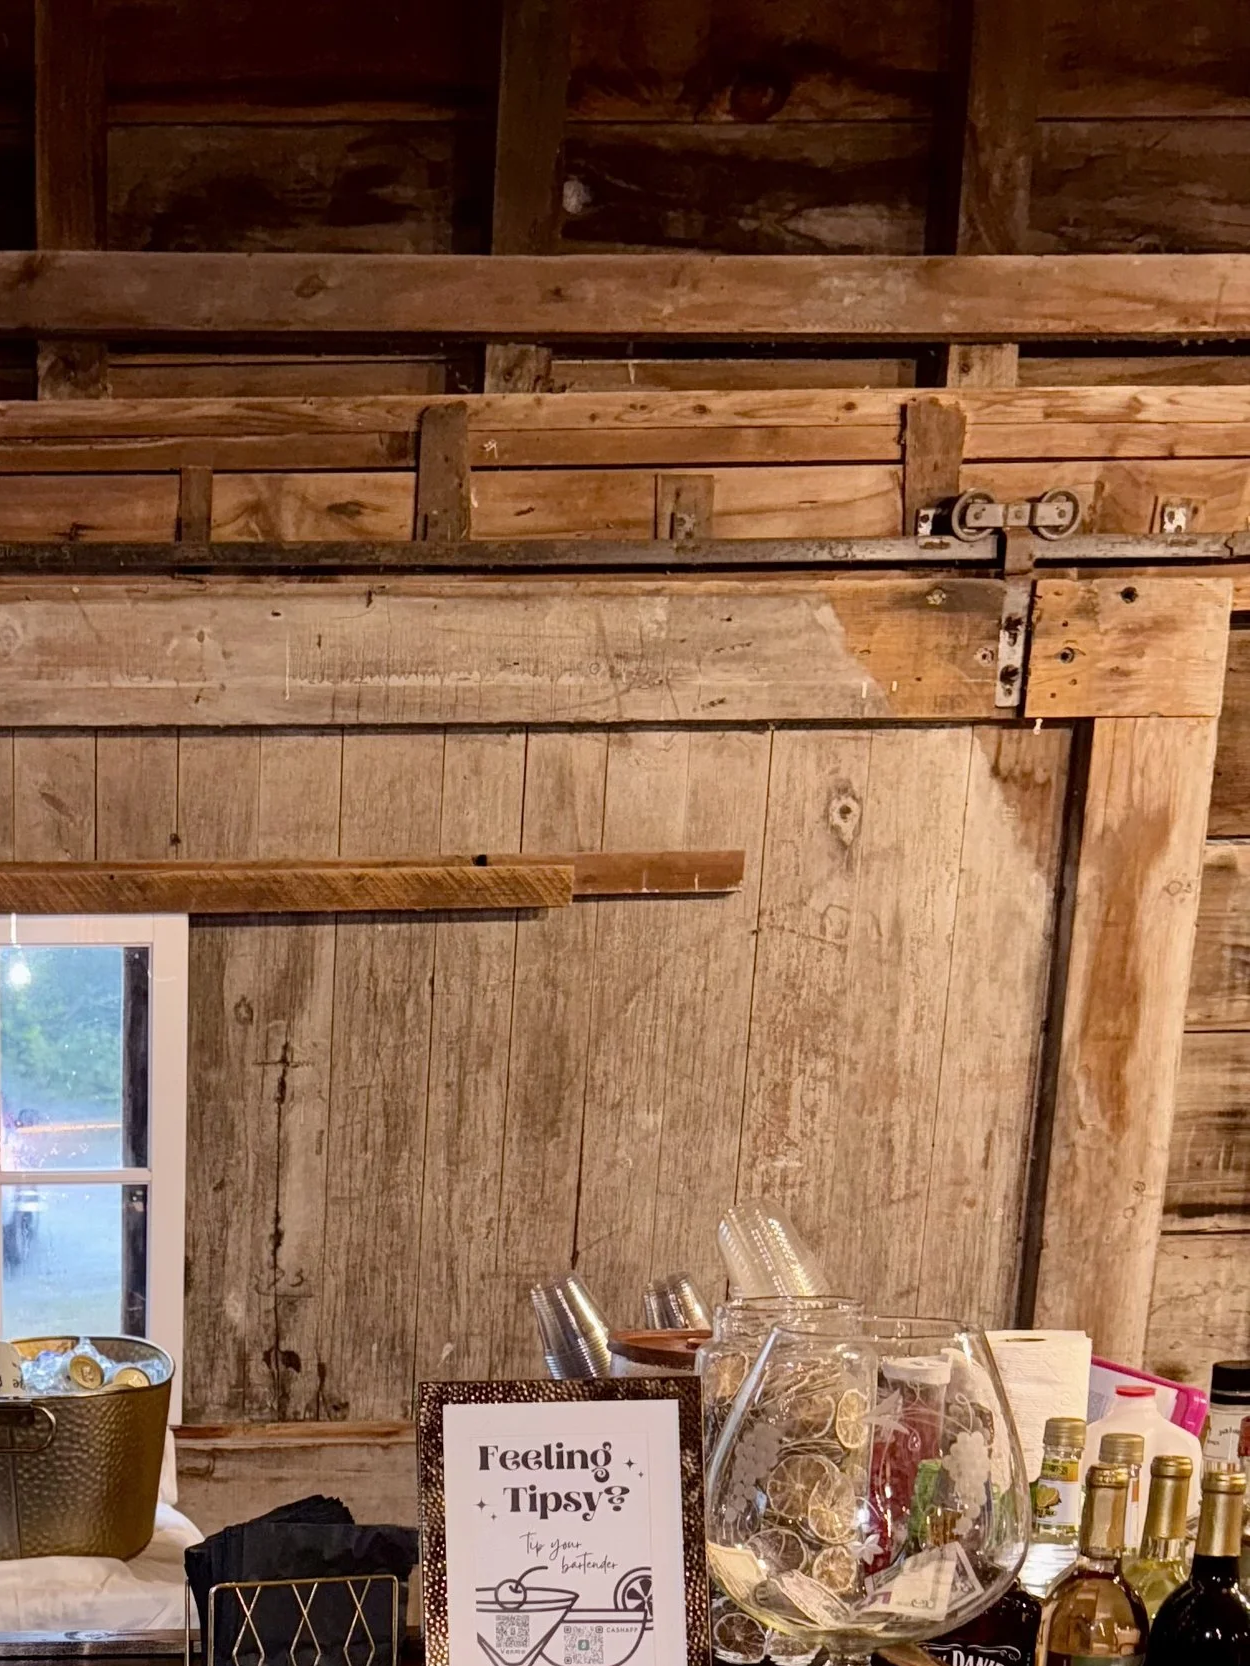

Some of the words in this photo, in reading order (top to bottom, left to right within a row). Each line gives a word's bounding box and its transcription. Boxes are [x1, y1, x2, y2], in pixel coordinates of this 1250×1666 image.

[478, 1441, 612, 1483] Feeling
[503, 1484, 630, 1521] Tipsy?
[519, 1532, 545, 1557] Tip
[549, 1538, 583, 1561] your
[560, 1552, 619, 1574] bartender
